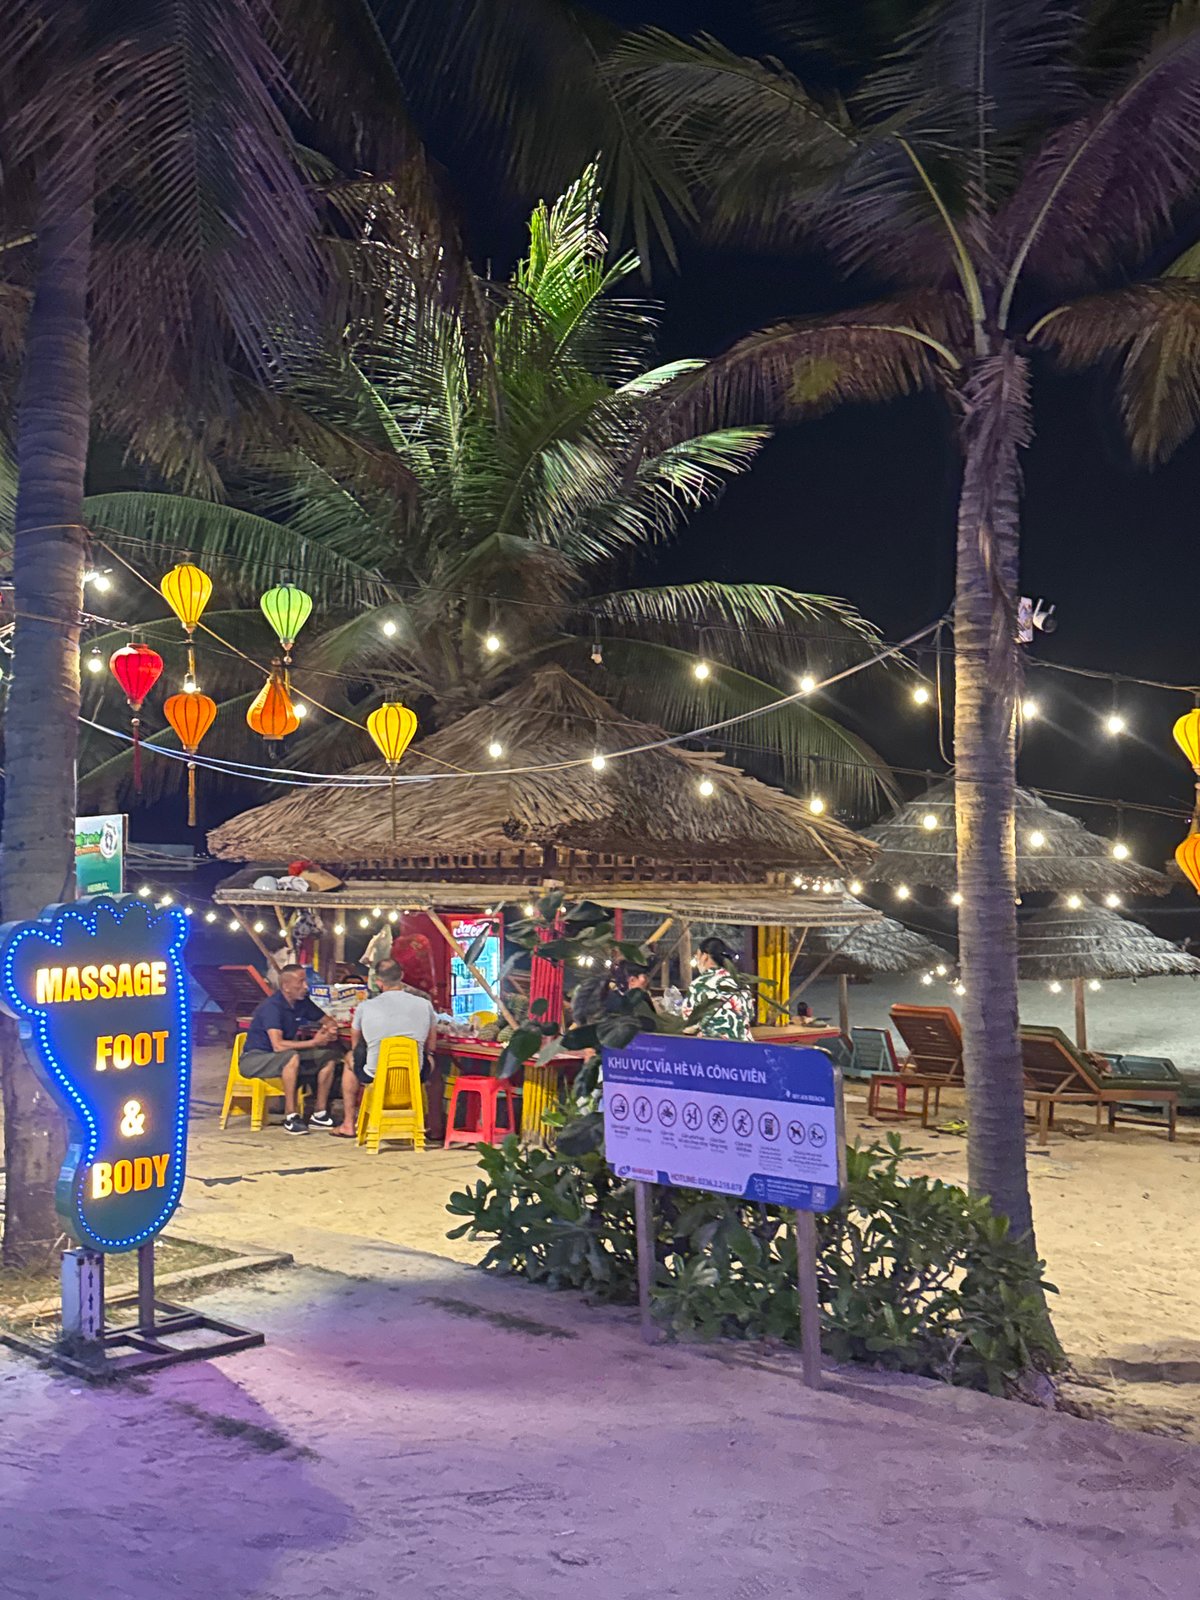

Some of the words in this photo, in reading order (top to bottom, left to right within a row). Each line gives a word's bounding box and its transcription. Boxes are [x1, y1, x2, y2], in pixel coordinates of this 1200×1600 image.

[36, 961, 167, 1005] MASSAGE
[95, 1030, 169, 1072] FOOT
[608, 1057, 629, 1070] KHU
[630, 1058, 653, 1075] VỰC
[674, 1061, 689, 1076] HÈ
[689, 1063, 705, 1078] VÀ
[706, 1064, 739, 1081] CÔNG
[739, 1068, 767, 1084] VIÊN
[120, 1100, 146, 1137] &
[92, 1153, 170, 1199] BODY
